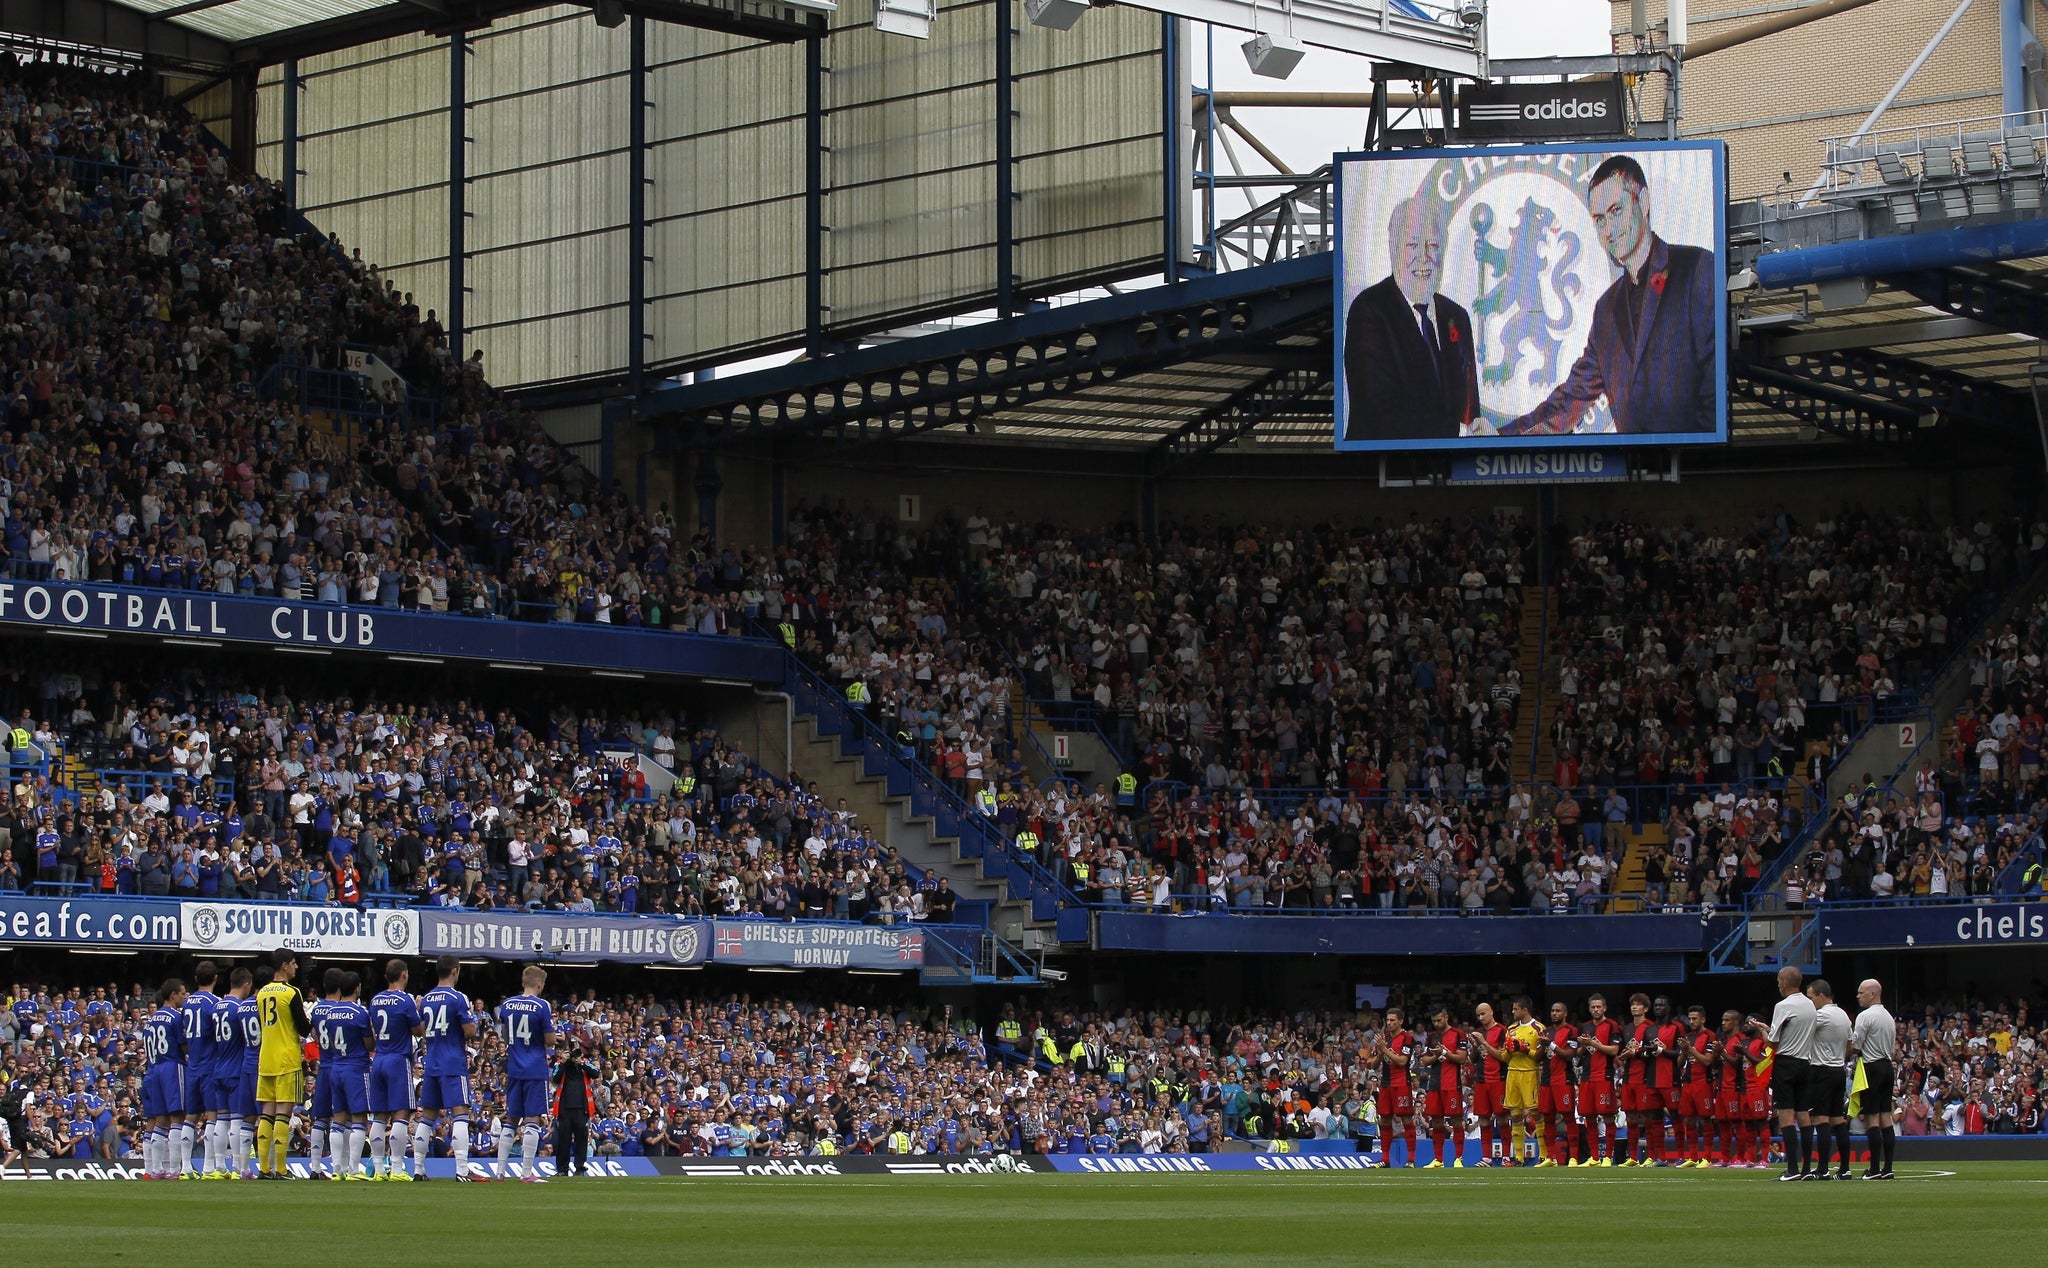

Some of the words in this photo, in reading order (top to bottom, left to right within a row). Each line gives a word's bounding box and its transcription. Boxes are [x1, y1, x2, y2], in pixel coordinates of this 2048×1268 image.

[1524, 98, 1607, 120] adidas
[1475, 452, 1604, 476] SAMSUNG
[0, 583, 227, 634] FOOTBALL
[271, 606, 375, 645] CLUB
[1058, 738, 1064, 756] 1
[1902, 726, 1913, 745] 2
[225, 909, 293, 935] SOUTH
[301, 911, 377, 937] DORSET
[1957, 906, 2044, 940] chels
[283, 938, 322, 949] CHELSEA
[436, 923, 524, 950] BRISTOL
[531, 928, 544, 950] &
[551, 927, 602, 952] BATH
[608, 928, 667, 954] BLUES
[744, 925, 805, 945] CHELSEA
[811, 927, 900, 948] SUPPORTERS
[794, 949, 850, 965] NORWAY
[426, 994, 446, 1003] CAHILL
[505, 1001, 538, 1012] SCHÜRRLE
[184, 1007, 202, 1039] 21
[262, 996, 278, 1027] 13
[423, 1004, 449, 1038] 24
[212, 1011, 232, 1042] 26
[241, 1016, 260, 1047] 19
[319, 1020, 330, 1050] 8
[377, 1009, 390, 1040] 2
[507, 1013, 532, 1045] 14
[334, 1026, 347, 1057] 4
[1398, 1096, 1409, 1107] 22
[1450, 1097, 1457, 1109] 2
[1754, 1100, 1764, 1112] 12
[746, 1159, 841, 1175] adidas
[1078, 1157, 1212, 1173] SAMSUNG
[1254, 1155, 1377, 1171] SAMSUNG
